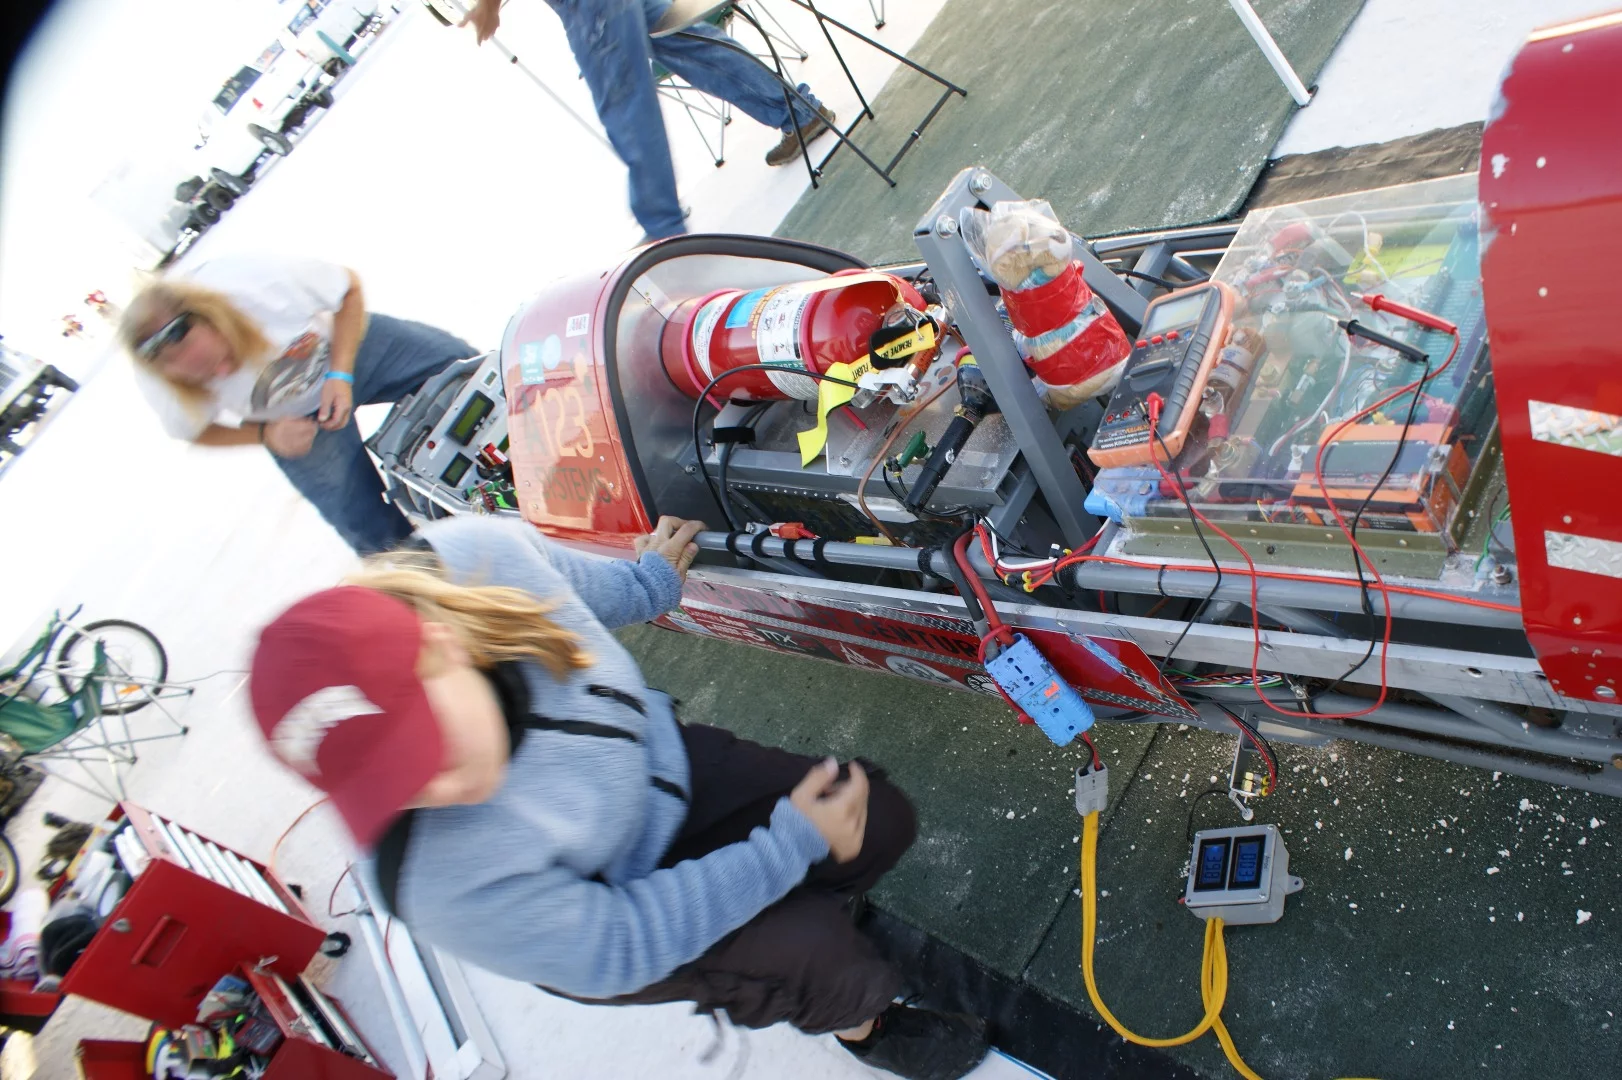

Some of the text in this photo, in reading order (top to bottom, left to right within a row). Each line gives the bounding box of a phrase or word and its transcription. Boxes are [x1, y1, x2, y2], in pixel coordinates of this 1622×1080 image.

[890, 338, 913, 357] REMOVE
[851, 362, 869, 381] FLIGHT
[534, 466, 612, 503] SYSTEMS
[853, 617, 979, 658] CENTUR
